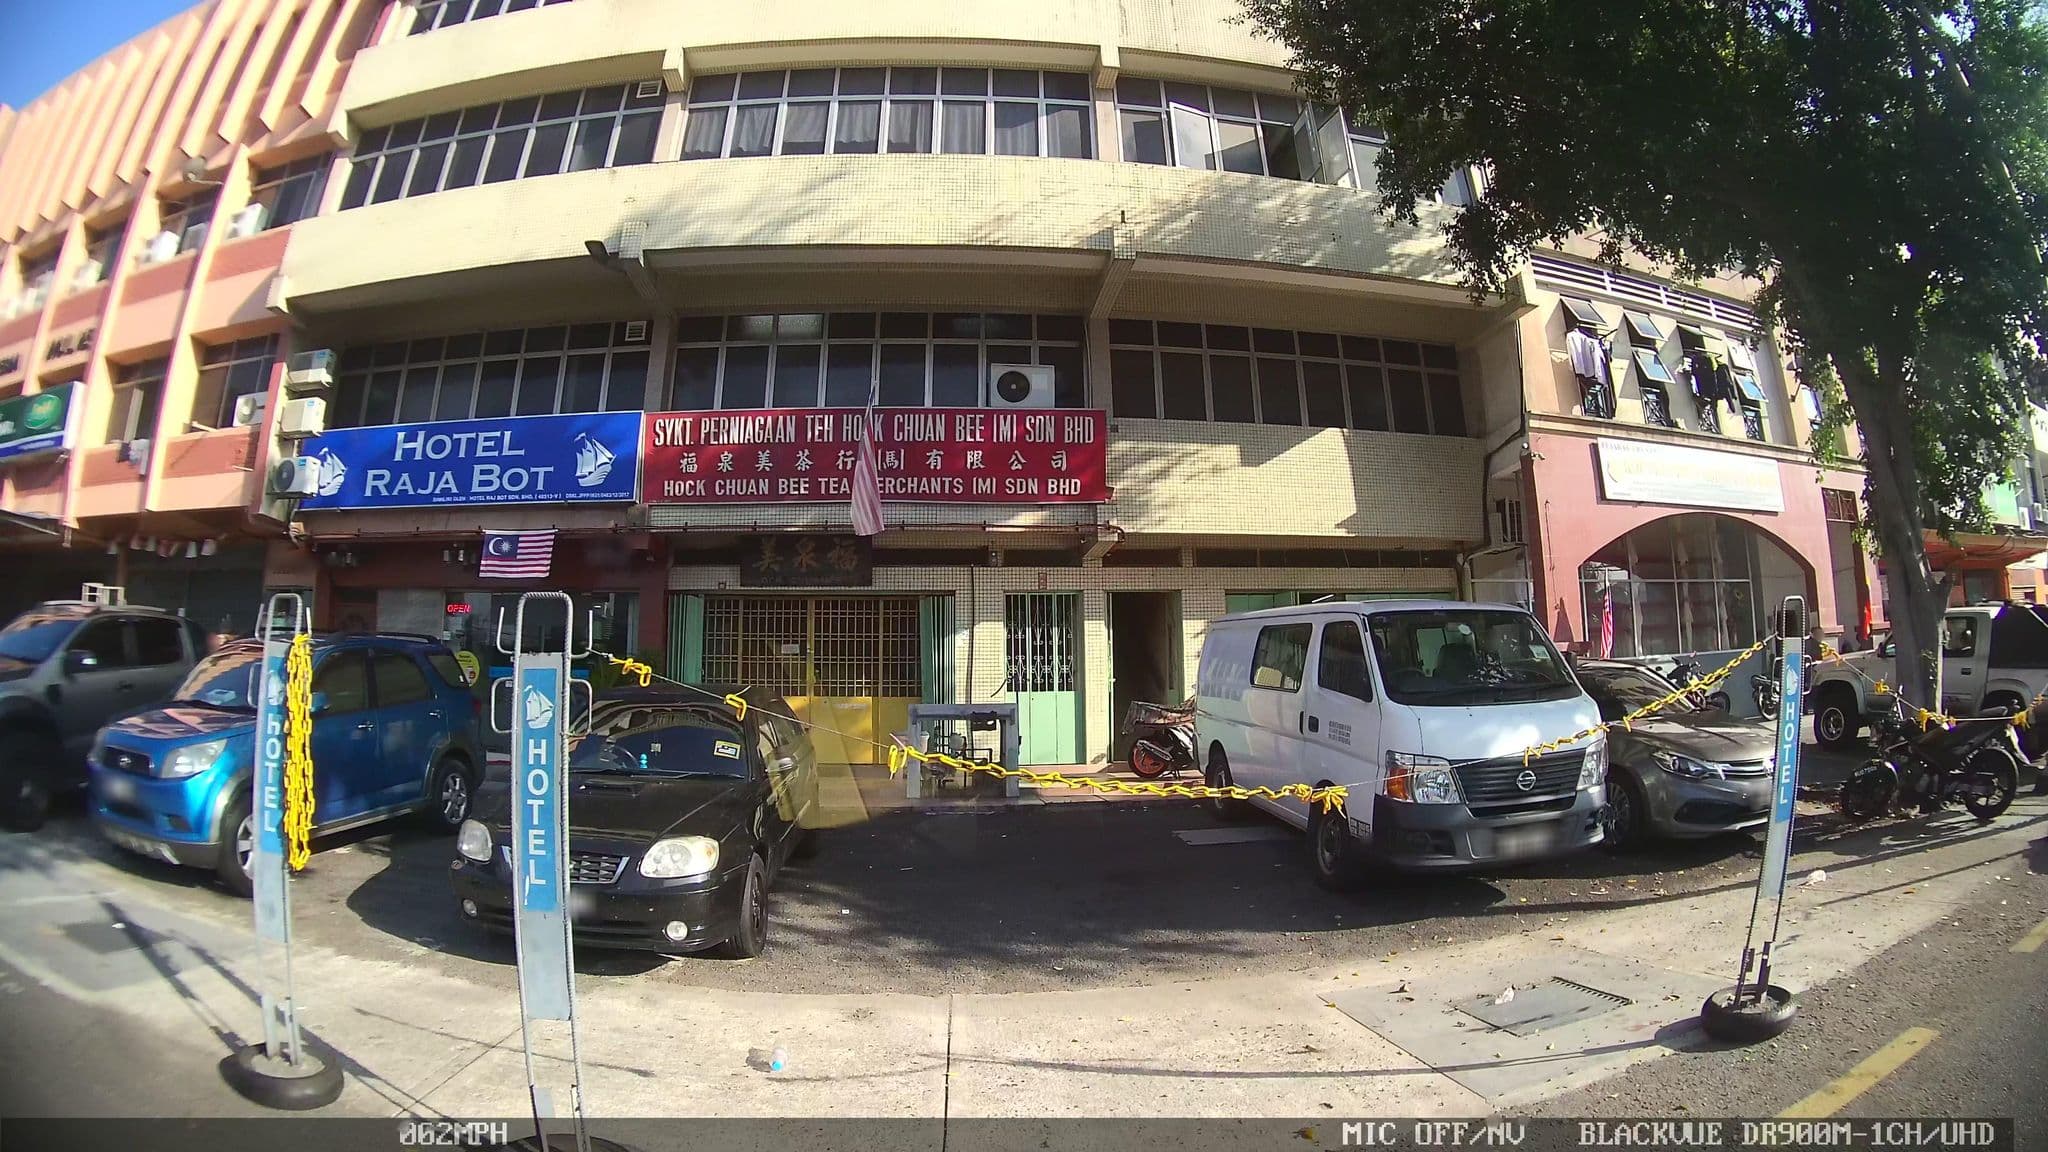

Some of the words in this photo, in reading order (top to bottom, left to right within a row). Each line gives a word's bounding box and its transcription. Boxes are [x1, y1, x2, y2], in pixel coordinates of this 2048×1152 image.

[393, 430, 524, 462] HOTEL
[655, 417, 694, 446] SYKT.
[700, 415, 796, 445] PERNIAGAAN
[805, 415, 833, 442] TEH
[842, 414, 883, 442] HOK
[893, 414, 945, 442] CHUAN
[955, 414, 985, 443] BEE
[1025, 415, 1054, 443] SDN
[1064, 416, 1094, 444] BHD
[364, 469, 459, 497] RAJA
[470, 464, 554, 494] BOT
[664, 480, 706, 497] HOCK
[715, 478, 769, 496] CHUAN
[778, 478, 809, 495] BEE
[818, 477, 850, 494] TEA
[877, 477, 963, 494] ERCHANTS
[1005, 478, 1038, 495] SDN
[1047, 479, 1081, 496] BHD
[447, 604, 472, 613] OPEN
[1779, 702, 1796, 804] HOTEL
[527, 738, 549, 885] HOTEL
